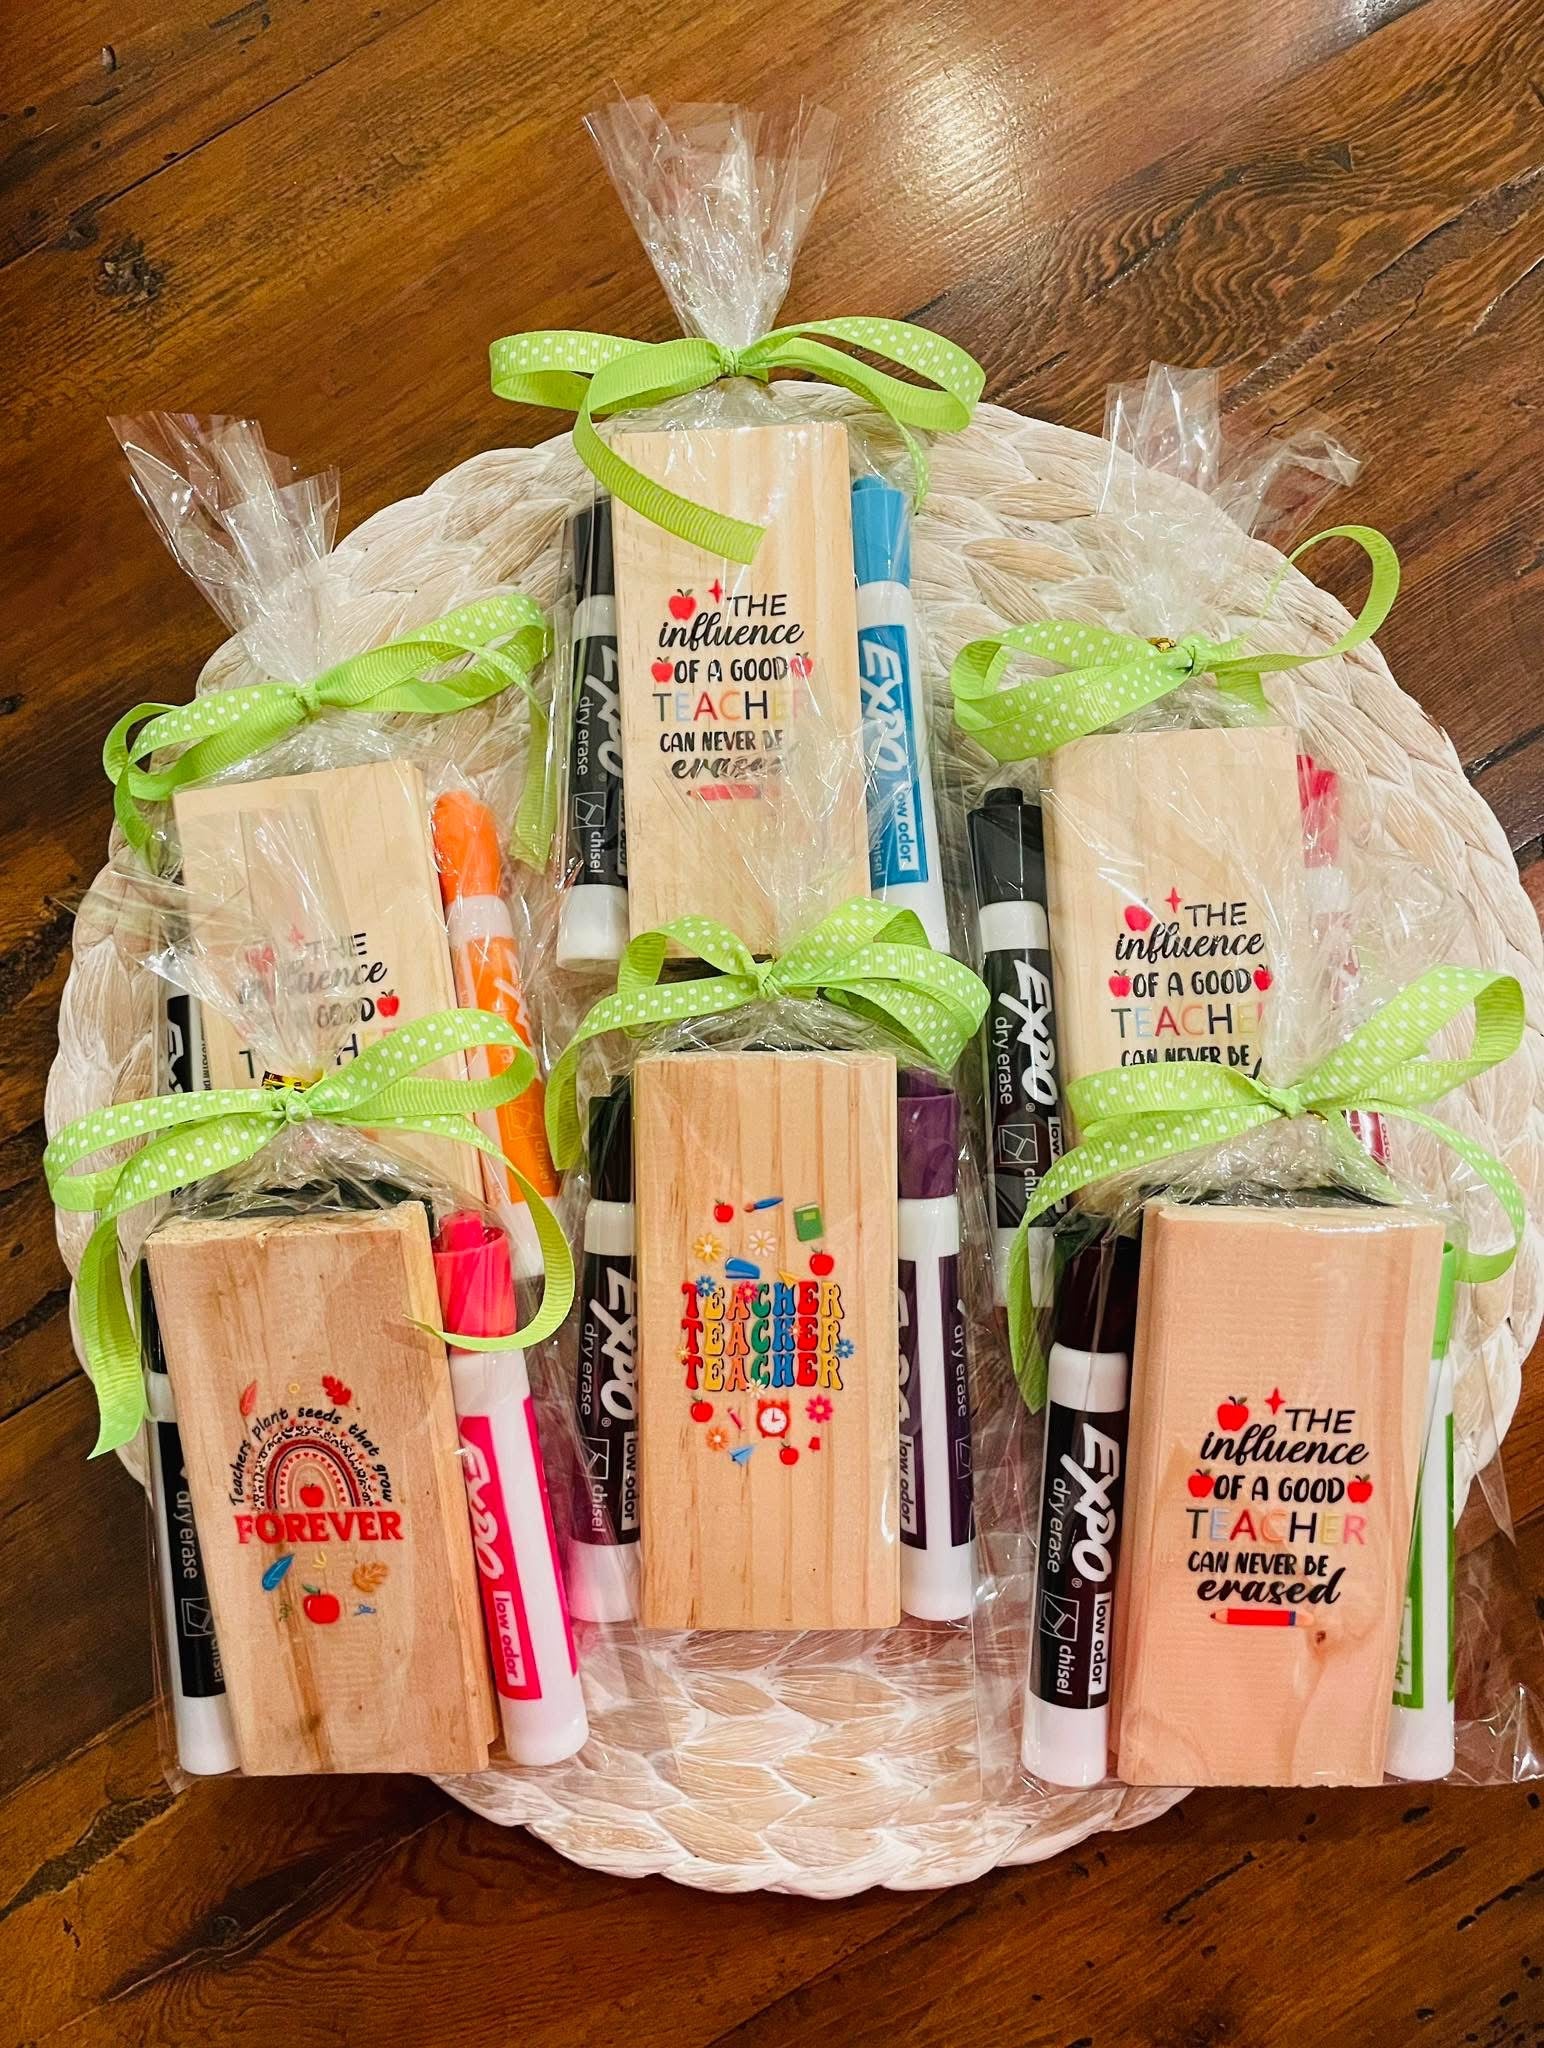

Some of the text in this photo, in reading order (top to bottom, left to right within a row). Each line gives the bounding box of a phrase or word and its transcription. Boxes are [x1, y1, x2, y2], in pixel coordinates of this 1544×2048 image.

[727, 593, 787, 617] THE
[658, 612, 804, 651] influence
[674, 656, 788, 684] OF A GOOD
[860, 639, 908, 772] EXPO
[575, 695, 595, 776] dry erase
[660, 731, 695, 753] CAN
[702, 730, 756, 752] NEVER
[671, 756, 783, 780] erase
[897, 786, 915, 863] ow odor
[590, 830, 604, 873] chisel
[873, 835, 886, 877] hisel
[1184, 902, 1247, 928] THE
[1115, 922, 1265, 964] influence
[1132, 968, 1252, 998] OF A GOOD
[998, 959, 1058, 1106] EXPO
[992, 1016, 1014, 1105] dry erase
[1121, 1045, 1250, 1067] CAN NEVER BE
[681, 1281, 845, 1321] TEACHER
[589, 1267, 638, 1420] EXPO
[681, 1317, 842, 1357] TEACHER
[580, 1323, 599, 1415] dry erase
[681, 1352, 844, 1392] TEACHER
[951, 1325, 967, 1417] dry erase
[1285, 1408, 1356, 1434] THE
[229, 1407, 393, 1507] Teachers plant seeds that grow
[1200, 1424, 1369, 1466] influence
[592, 1483, 608, 1533] chisel
[624, 1477, 637, 1520] odor
[901, 1480, 915, 1525] odor
[1060, 1422, 1120, 1582] EXPO
[1213, 1474, 1345, 1503] OF A GOOD
[234, 1511, 404, 1545] FOREVER
[1047, 1477, 1071, 1574] dry erase
[1186, 1508, 1367, 1545] TEACHER
[180, 1528, 199, 1579] erase
[1187, 1551, 1329, 1577] CAN NEVER BE
[1197, 1567, 1346, 1605] erased
[495, 1597, 520, 1679] low odor
[1091, 1599, 1110, 1685] low odor
[1056, 1644, 1076, 1696] chisel
